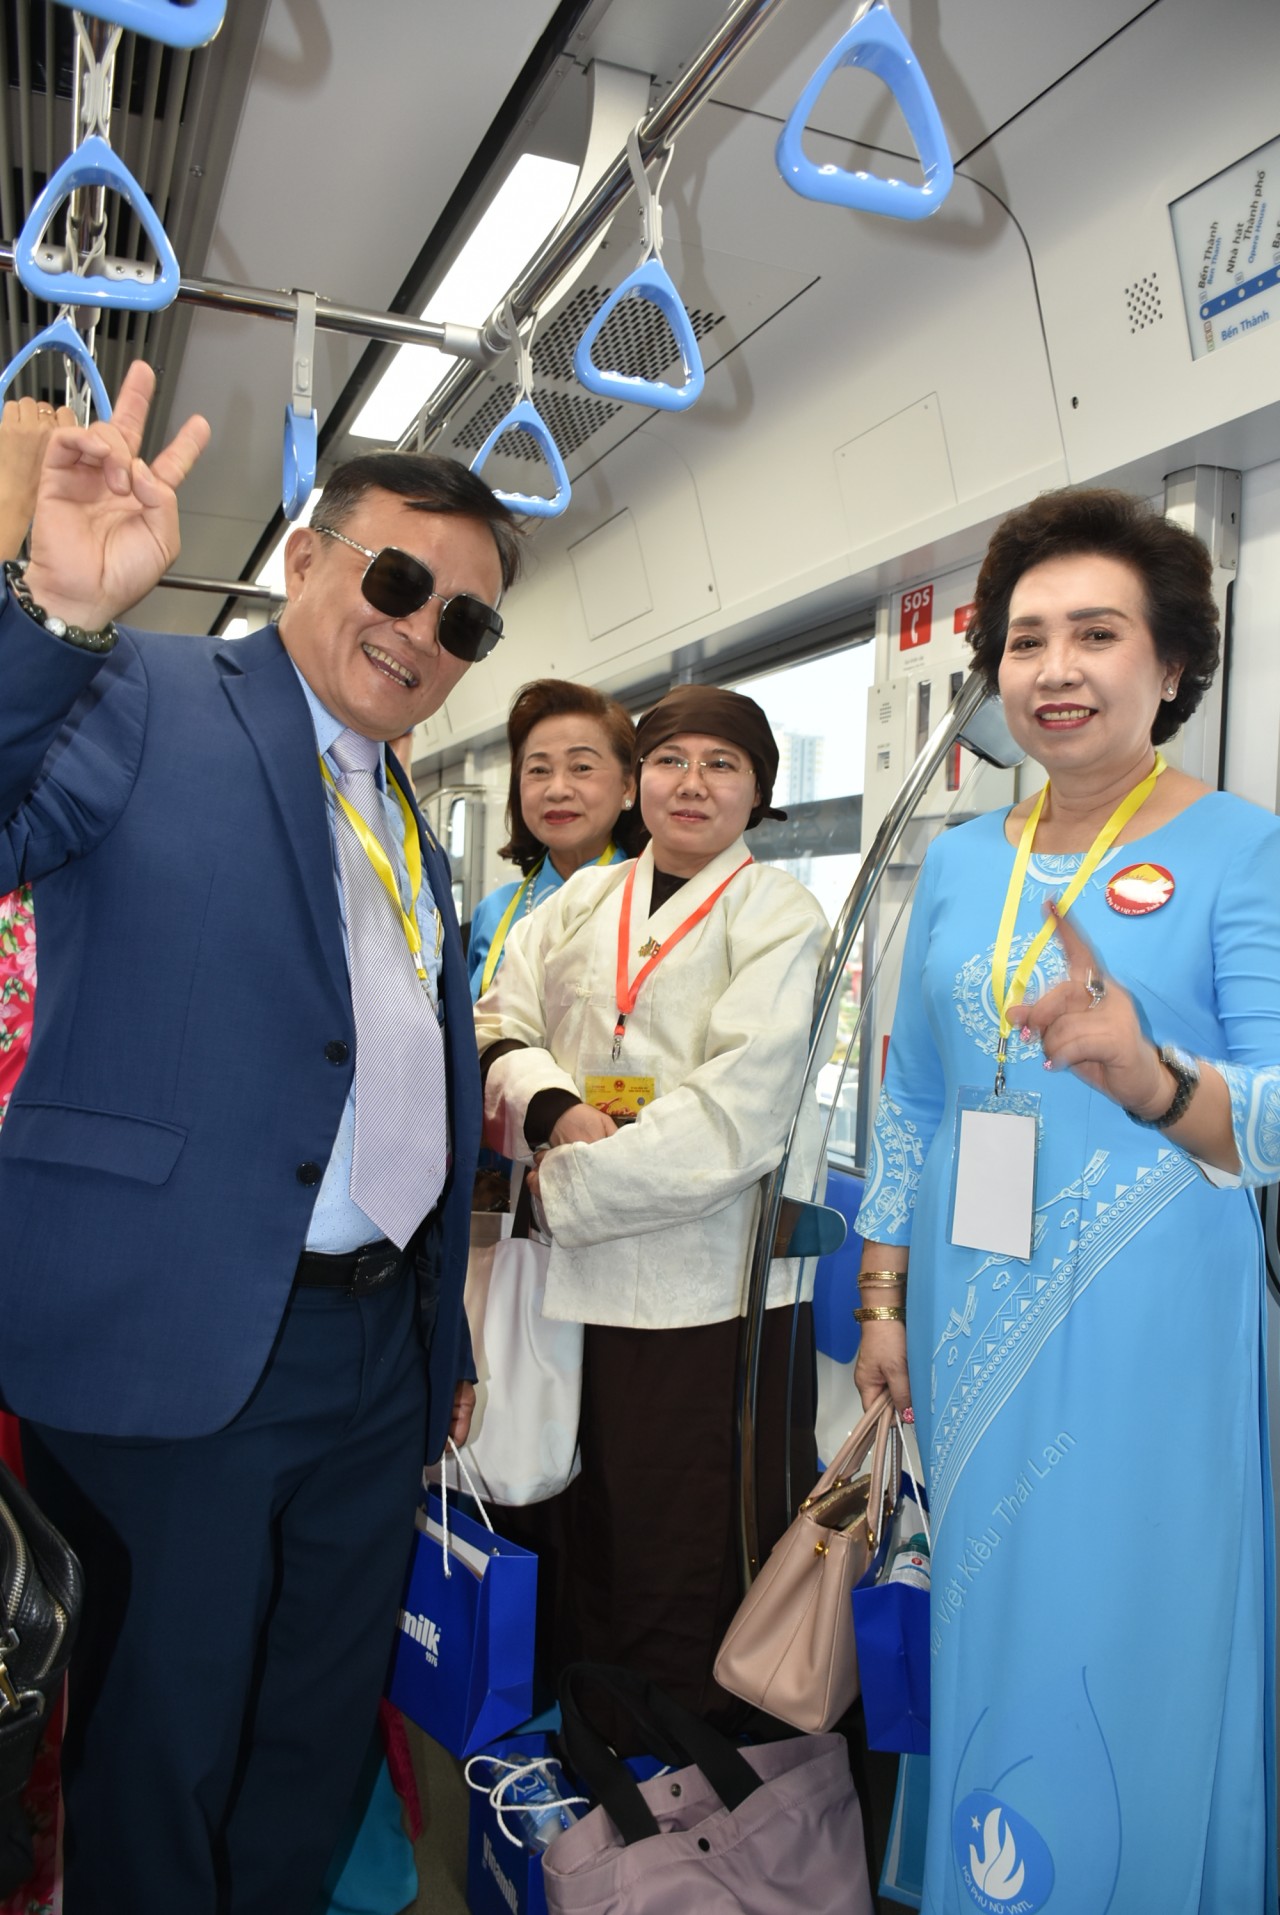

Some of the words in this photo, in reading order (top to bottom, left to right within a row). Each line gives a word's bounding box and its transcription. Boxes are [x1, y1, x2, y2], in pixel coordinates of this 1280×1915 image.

[1248, 235, 1259, 263] Opera
[1255, 202, 1266, 232] House
[1240, 310, 1269, 331] Thành
[903, 588, 930, 613] SOS
[936, 1579, 967, 1624] Việt
[957, 1527, 1003, 1582] Kiều
[991, 1473, 1034, 1526] Thái
[1028, 1431, 1077, 1479] Lan
[399, 1609, 440, 1657] milk
[425, 1651, 438, 1668] 1976
[1006, 1900, 1034, 1915] VNTL
